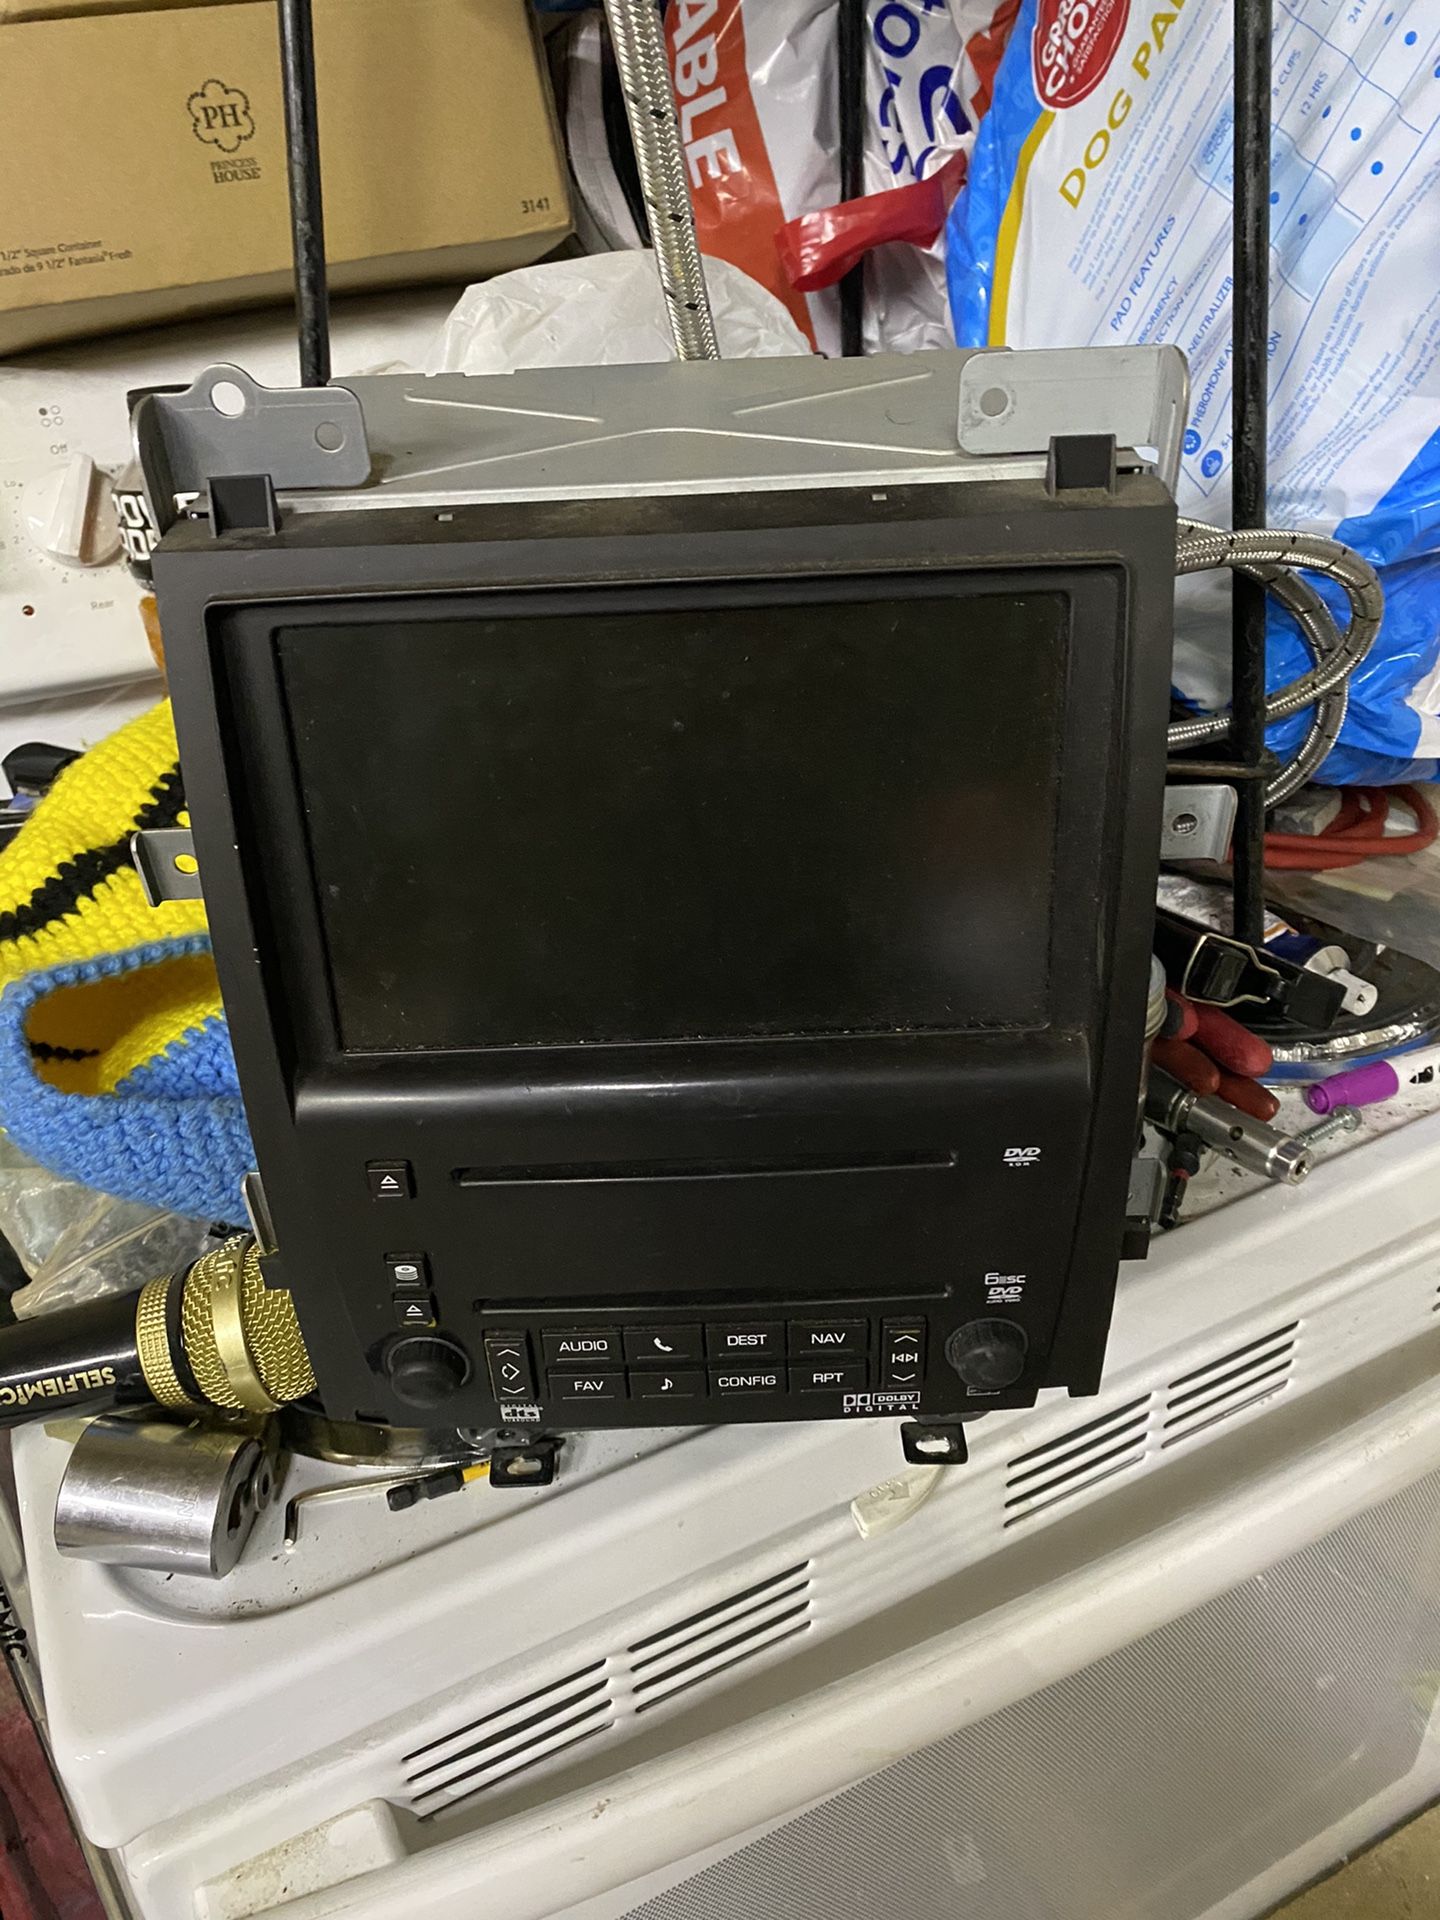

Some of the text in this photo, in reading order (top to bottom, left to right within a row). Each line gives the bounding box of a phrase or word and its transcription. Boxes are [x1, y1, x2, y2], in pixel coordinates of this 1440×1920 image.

[1278, 50, 1301, 85] CUPS
[1308, 71, 1329, 100] HRS
[200, 103, 243, 130] PH
[1058, 88, 1133, 209] DOG
[210, 157, 259, 172] PRINCESS
[213, 166, 262, 184] HOUSE
[521, 196, 550, 214] 3141
[1110, 296, 1132, 331] PAD
[1130, 215, 1176, 297] FEATURES
[1192, 361, 1227, 428] PHEROMONE
[1004, 1147, 1041, 1157] DVD
[988, 1286, 1023, 1295] DVD
[727, 1334, 767, 1346] DEST
[811, 1333, 846, 1344] NAV
[559, 1340, 608, 1352] AUDIO
[718, 1375, 777, 1387] CONFIG
[813, 1372, 844, 1383] RPT
[574, 1381, 604, 1392] FAV
[877, 1394, 915, 1402] DOLBY
[843, 1404, 919, 1413] DIGITAL
